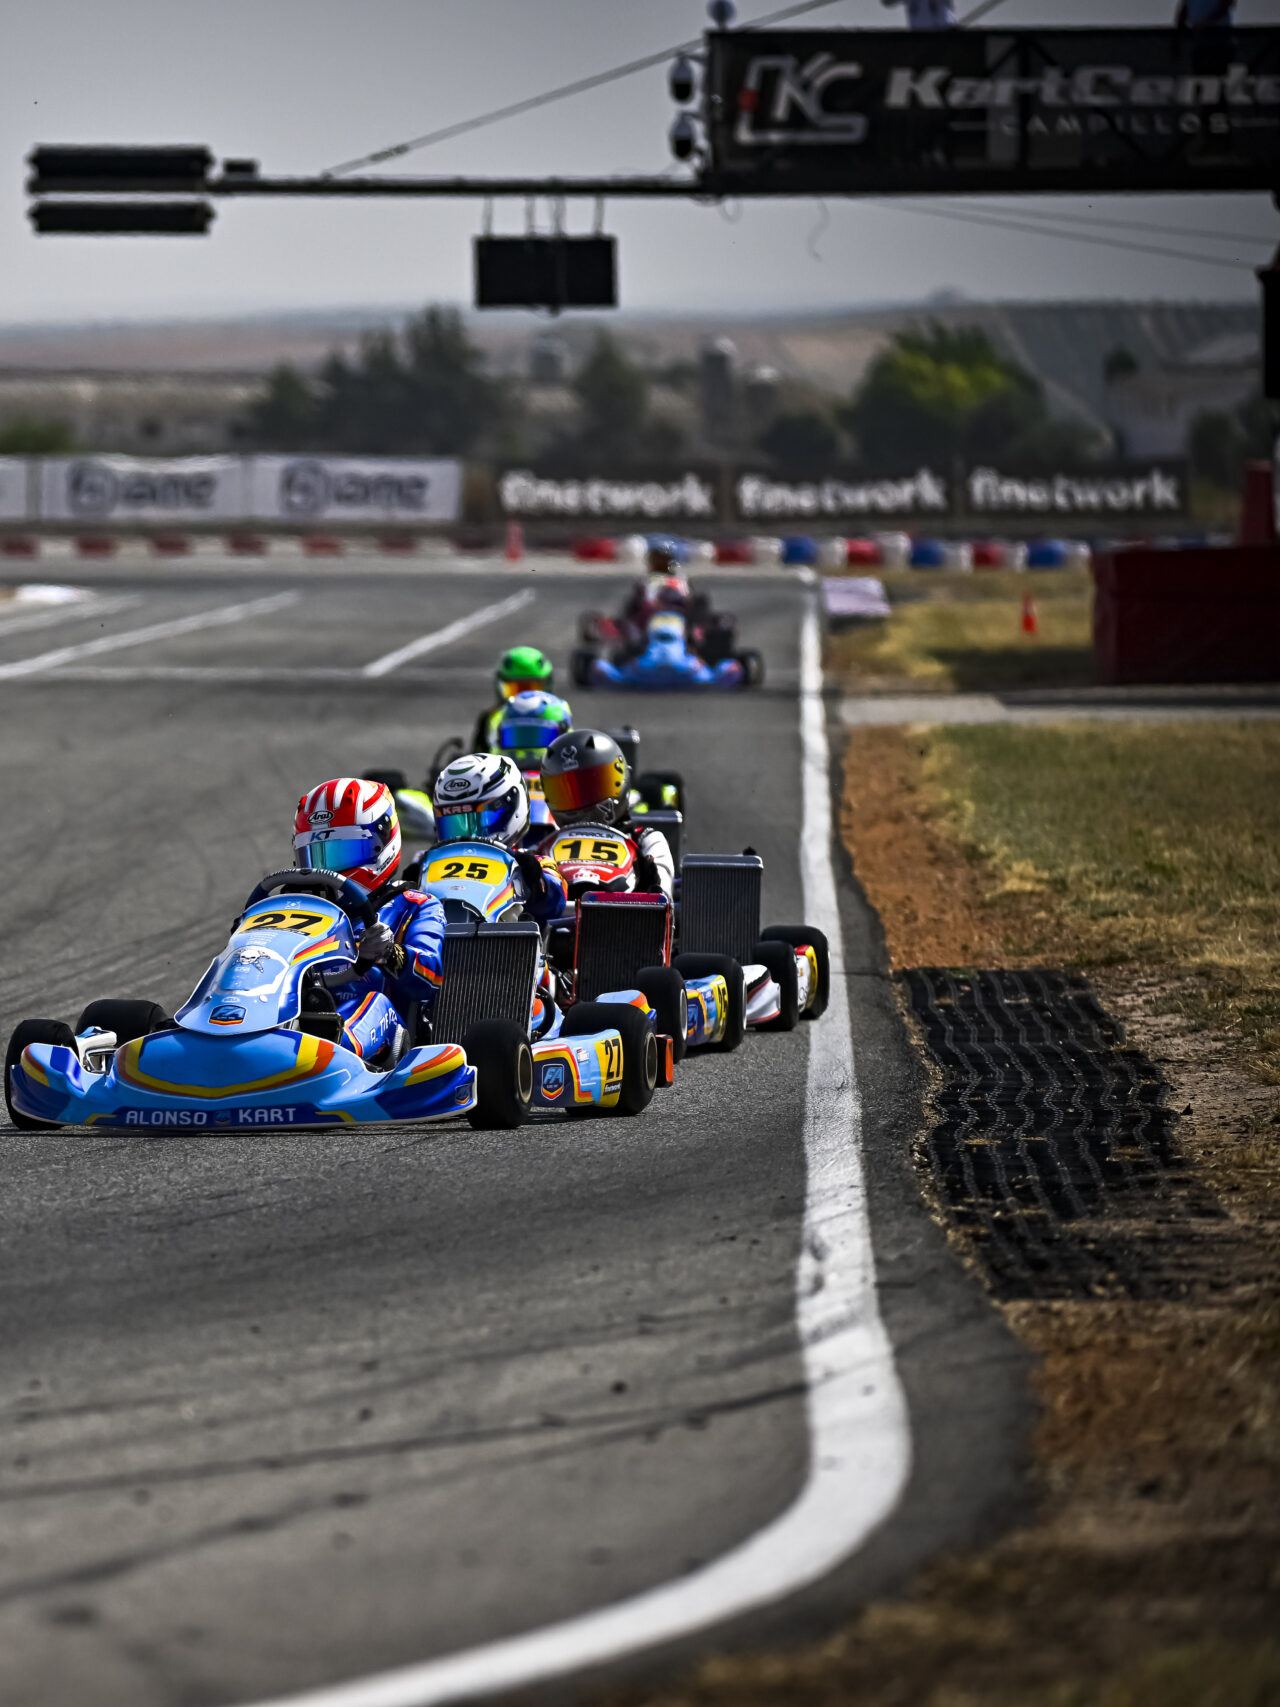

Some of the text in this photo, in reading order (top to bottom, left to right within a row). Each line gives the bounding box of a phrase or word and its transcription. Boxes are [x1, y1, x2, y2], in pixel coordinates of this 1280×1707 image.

[1001, 113, 1229, 135] CAMPILLOS
[500, 470, 715, 516] finetwork
[738, 468, 948, 516] finetwork
[970, 466, 1180, 513] finetwork
[442, 804, 472, 816] KRS
[561, 840, 618, 862] 15
[441, 862, 489, 880] 25
[246, 913, 323, 931] 27
[605, 1038, 620, 1080] 27
[125, 1107, 297, 1126] ALONSO KART
